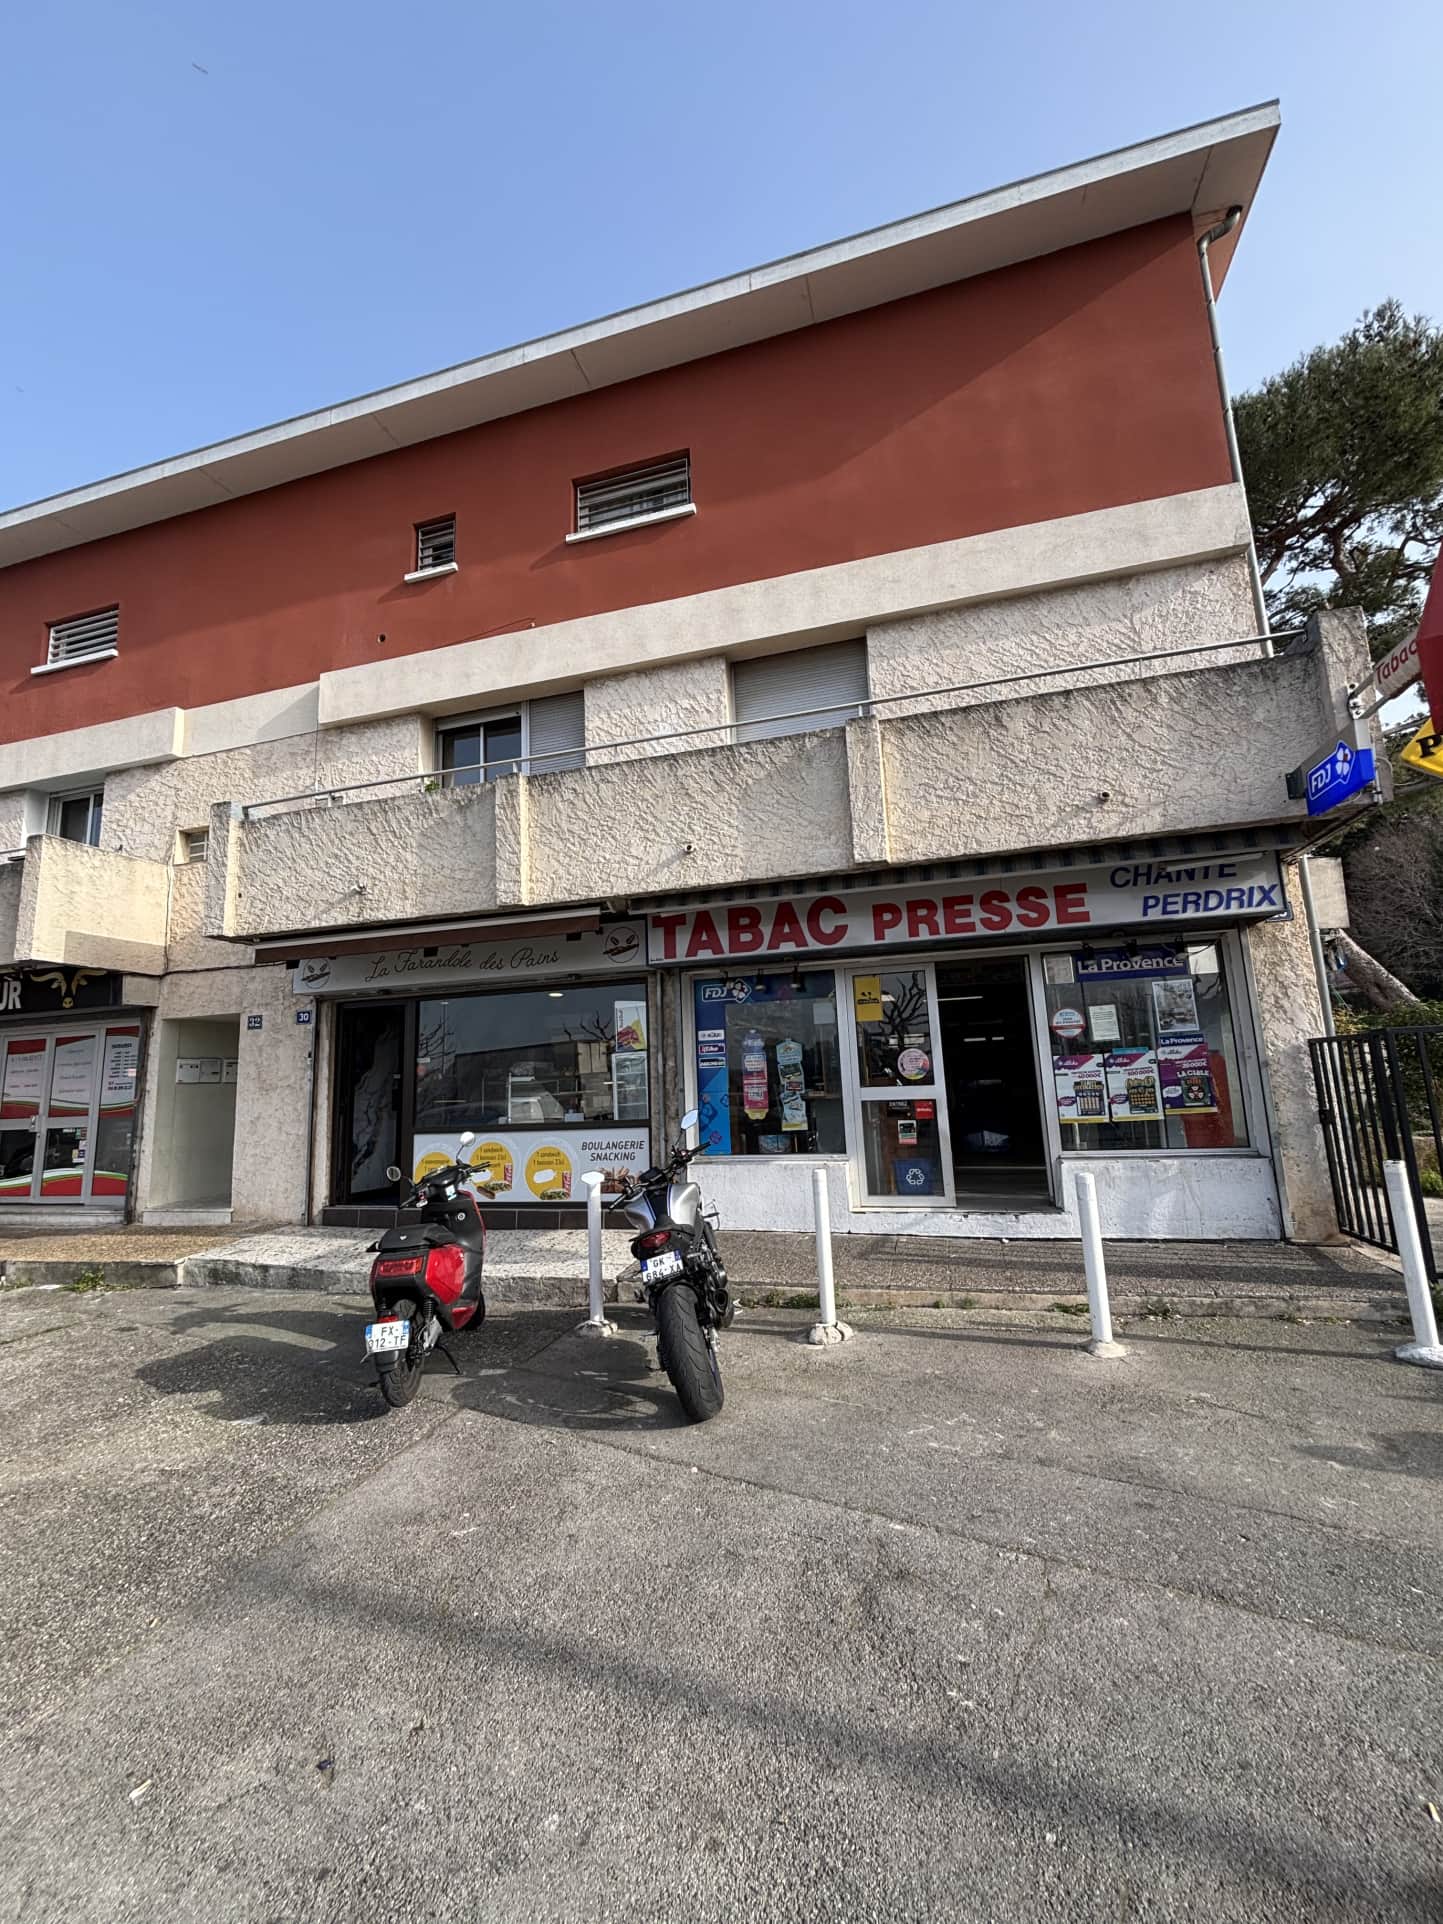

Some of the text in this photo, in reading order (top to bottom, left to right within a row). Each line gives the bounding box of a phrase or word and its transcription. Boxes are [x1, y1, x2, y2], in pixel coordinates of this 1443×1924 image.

[1376, 639, 1418, 684] Tabac
[1311, 763, 1331, 793] FDJ
[1142, 884, 1279, 917] PERDRIX
[652, 883, 1091, 960] TABAC PRESSE
[364, 947, 560, 982] La Farandole des Pains
[1078, 960, 1098, 974] La
[704, 987, 728, 999] FDJ
[298, 1012, 309, 1022] 30
[581, 1140, 646, 1151] BOULANGERIE
[589, 1151, 636, 1162] SNACKING
